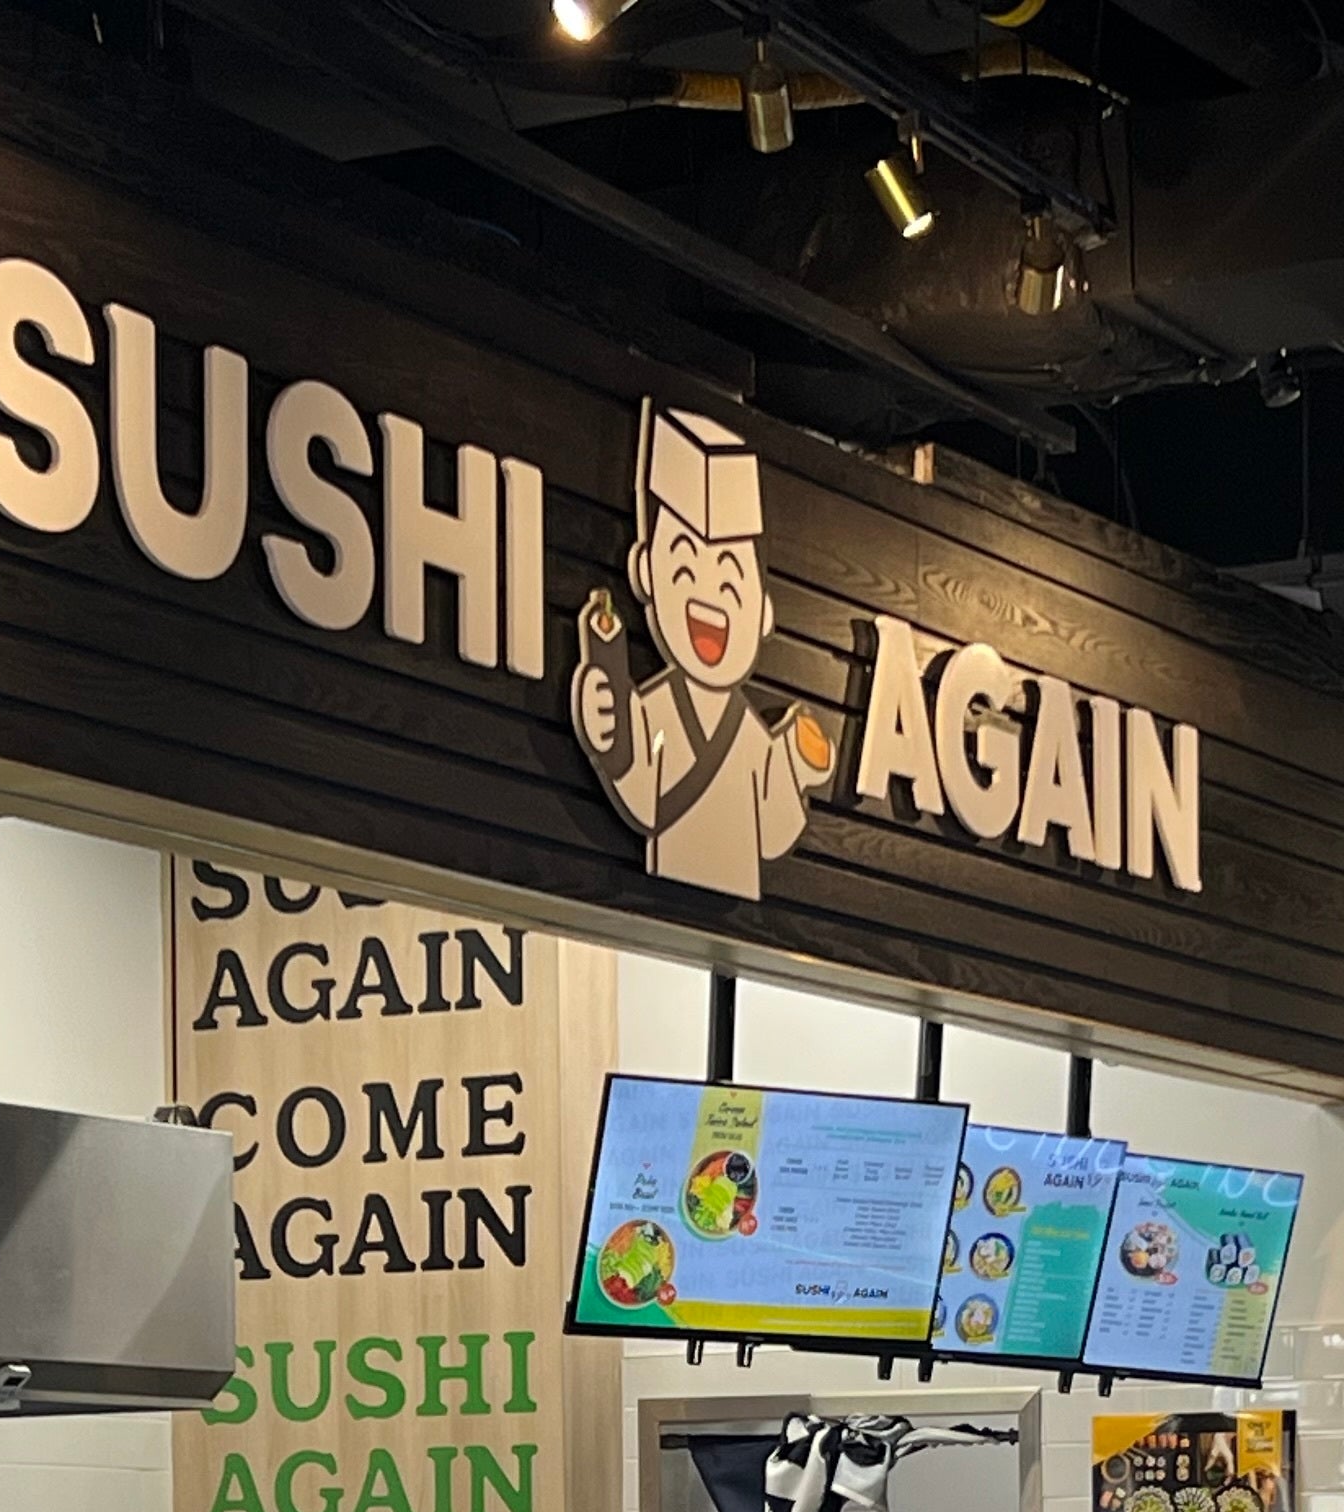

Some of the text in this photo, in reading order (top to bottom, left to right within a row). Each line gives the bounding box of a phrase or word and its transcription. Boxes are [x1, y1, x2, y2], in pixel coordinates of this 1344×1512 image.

[853, 612, 1203, 893] AGAIN
[192, 929, 528, 1031] AGAIN
[197, 1072, 526, 1173] COME
[199, 1331, 538, 1426] SUSHI
